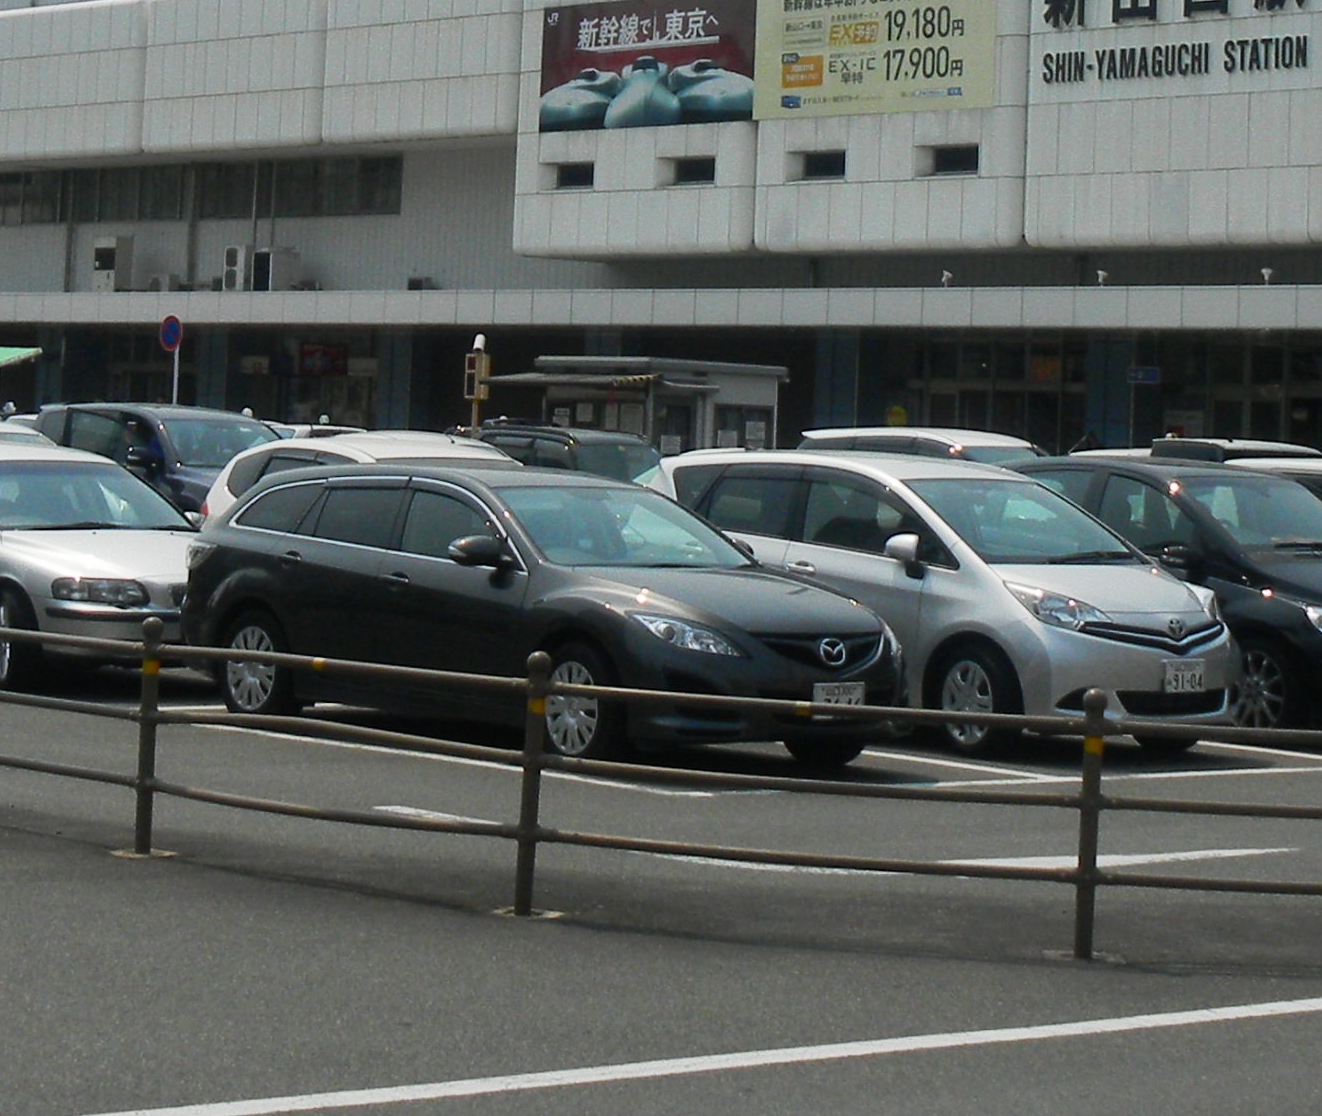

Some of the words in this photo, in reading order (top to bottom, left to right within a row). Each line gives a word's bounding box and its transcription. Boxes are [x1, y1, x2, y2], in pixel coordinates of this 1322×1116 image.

[884, 5, 965, 42] 19,180円
[883, 46, 964, 81] 17,900円
[1043, 42, 1210, 83] SHIN-YAMAGUCHI
[1223, 35, 1308, 73] STATION
